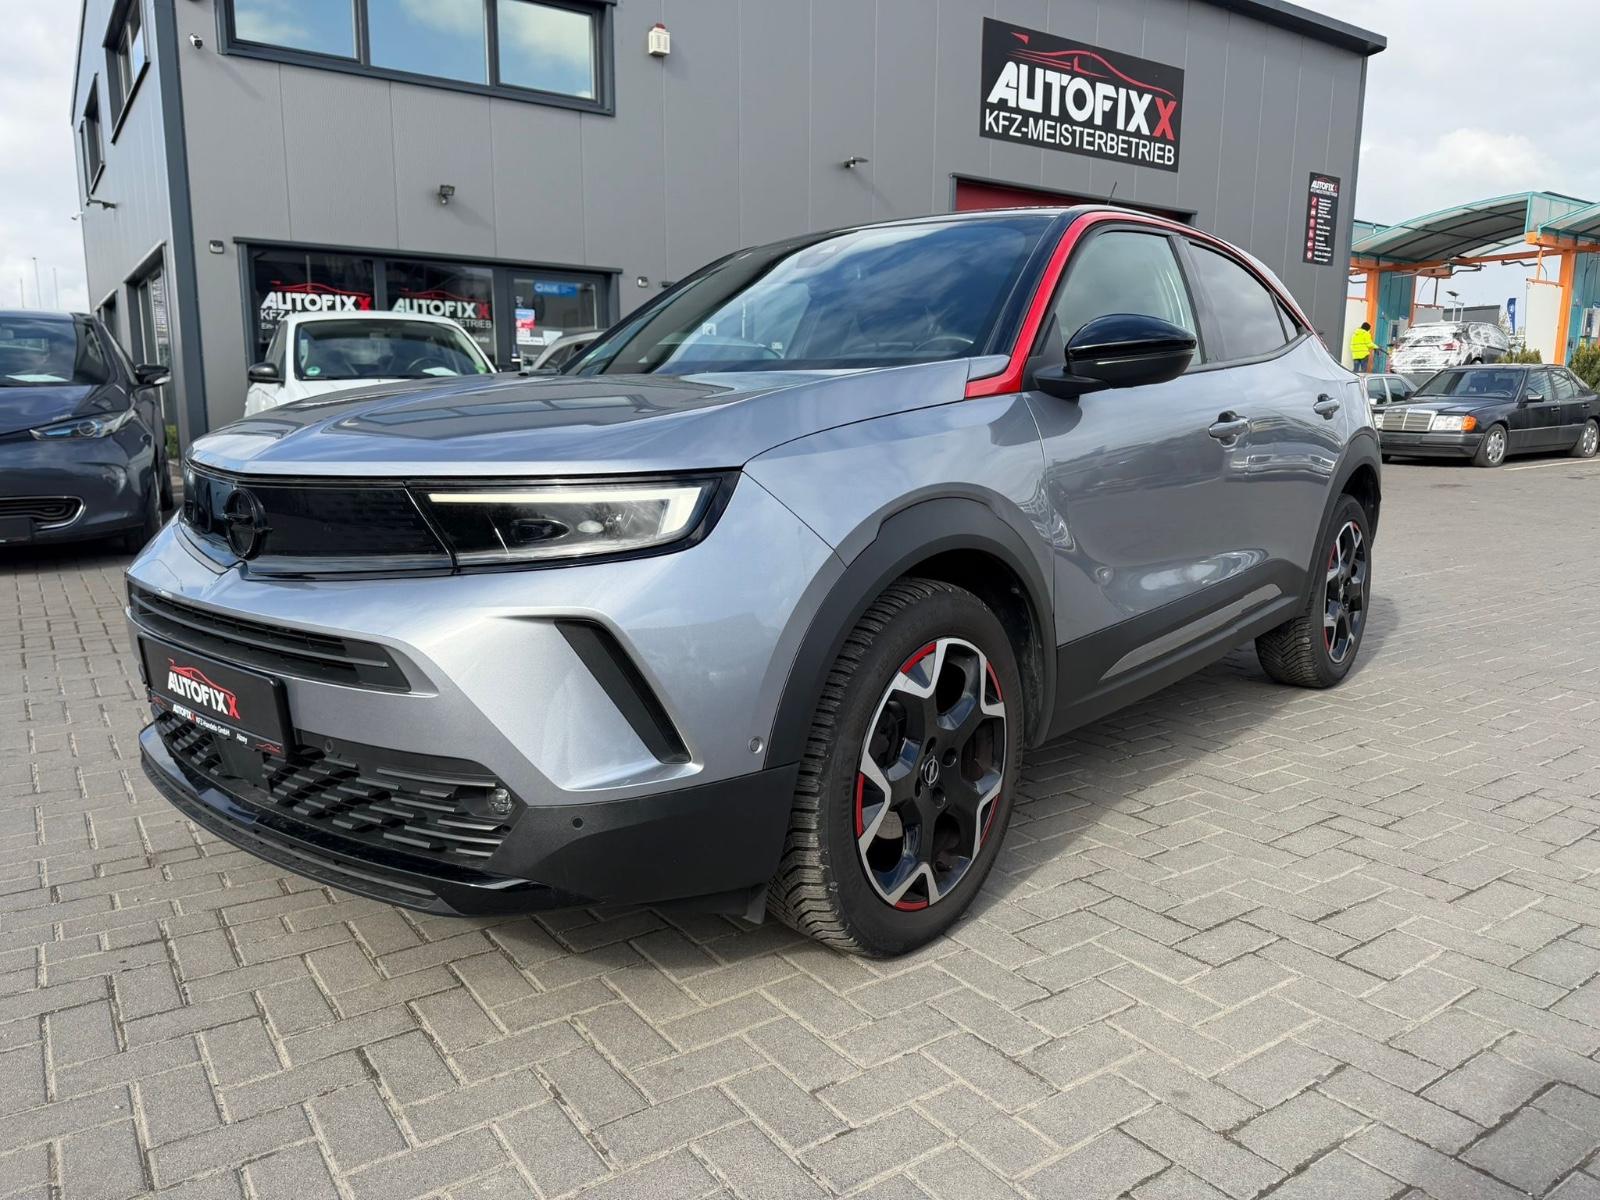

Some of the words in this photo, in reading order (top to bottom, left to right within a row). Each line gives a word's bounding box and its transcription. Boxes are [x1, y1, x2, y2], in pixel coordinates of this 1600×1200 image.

[986, 61, 1177, 141] AUTOFIXX
[985, 108, 1176, 166] KFZ-MEISTERBETRIEB
[260, 291, 372, 312] AUTOFIXX
[391, 297, 492, 320] AUTOFIXX
[168, 671, 240, 720] AUTOFIXX
